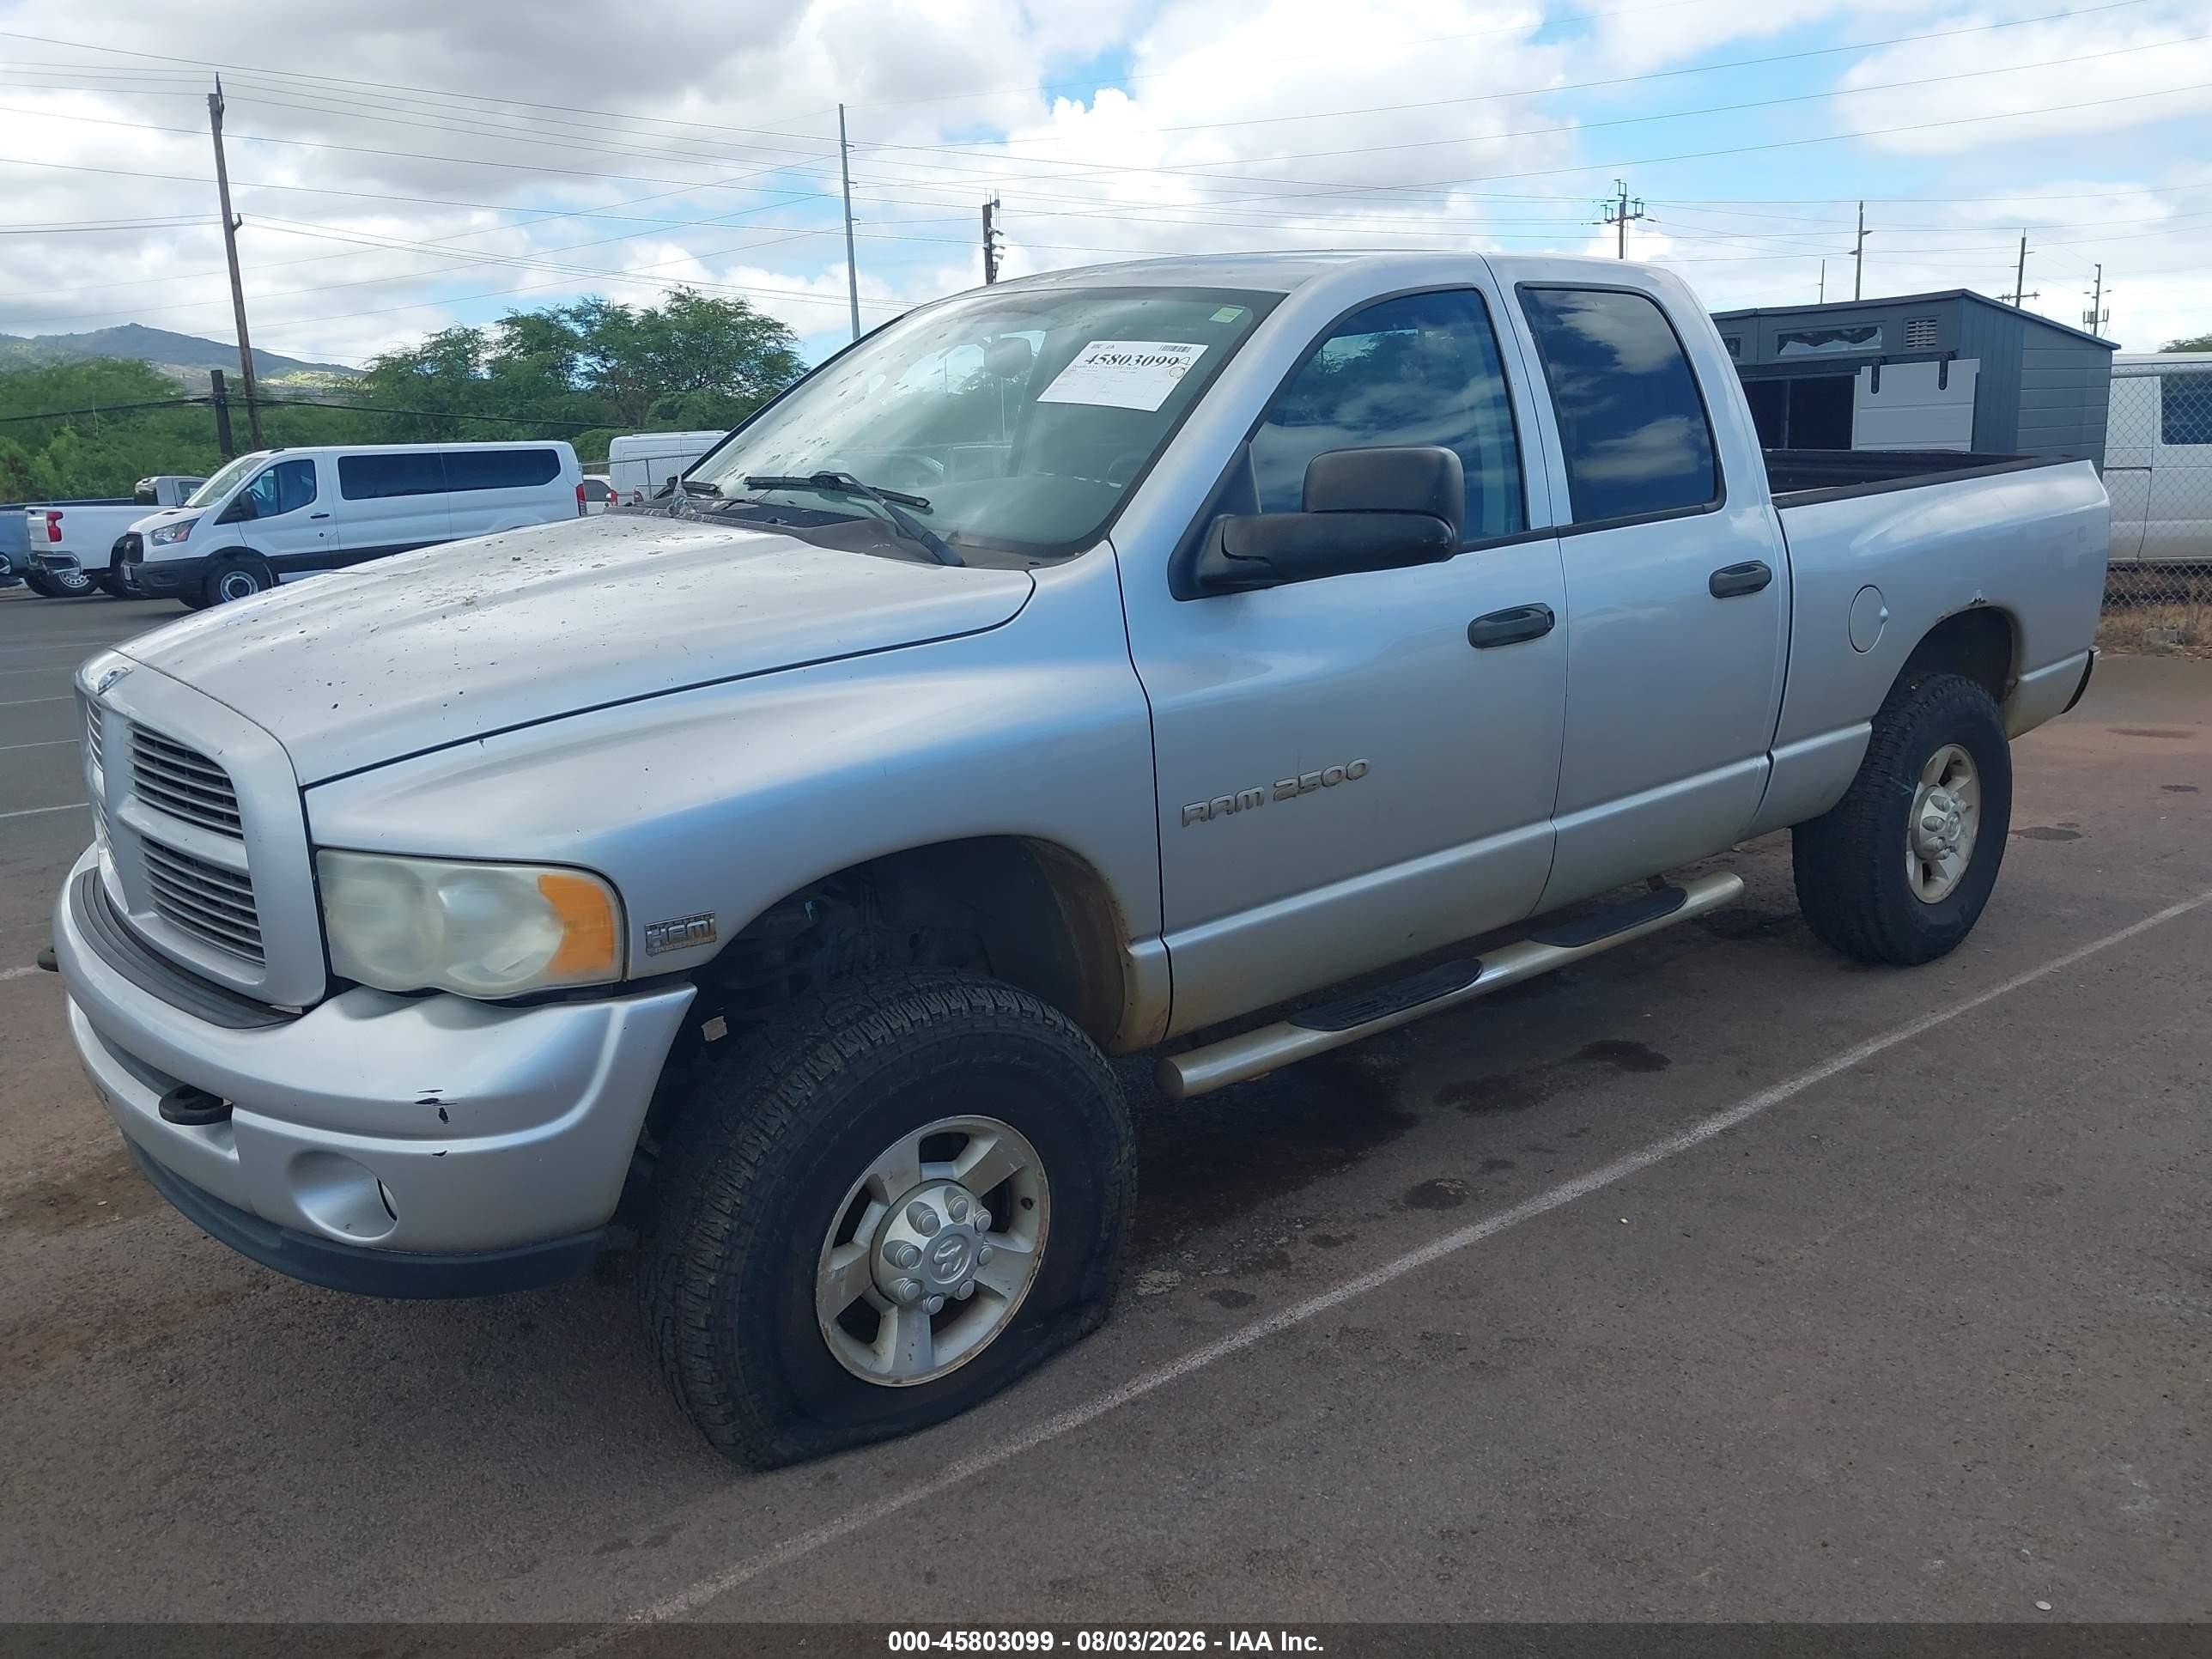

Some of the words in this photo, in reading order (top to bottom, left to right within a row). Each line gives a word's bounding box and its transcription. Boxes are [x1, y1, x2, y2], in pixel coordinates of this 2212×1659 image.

[1085, 353, 1180, 368] 45803099
[1182, 786, 1265, 828] RAM
[1272, 757, 1370, 802] 2500
